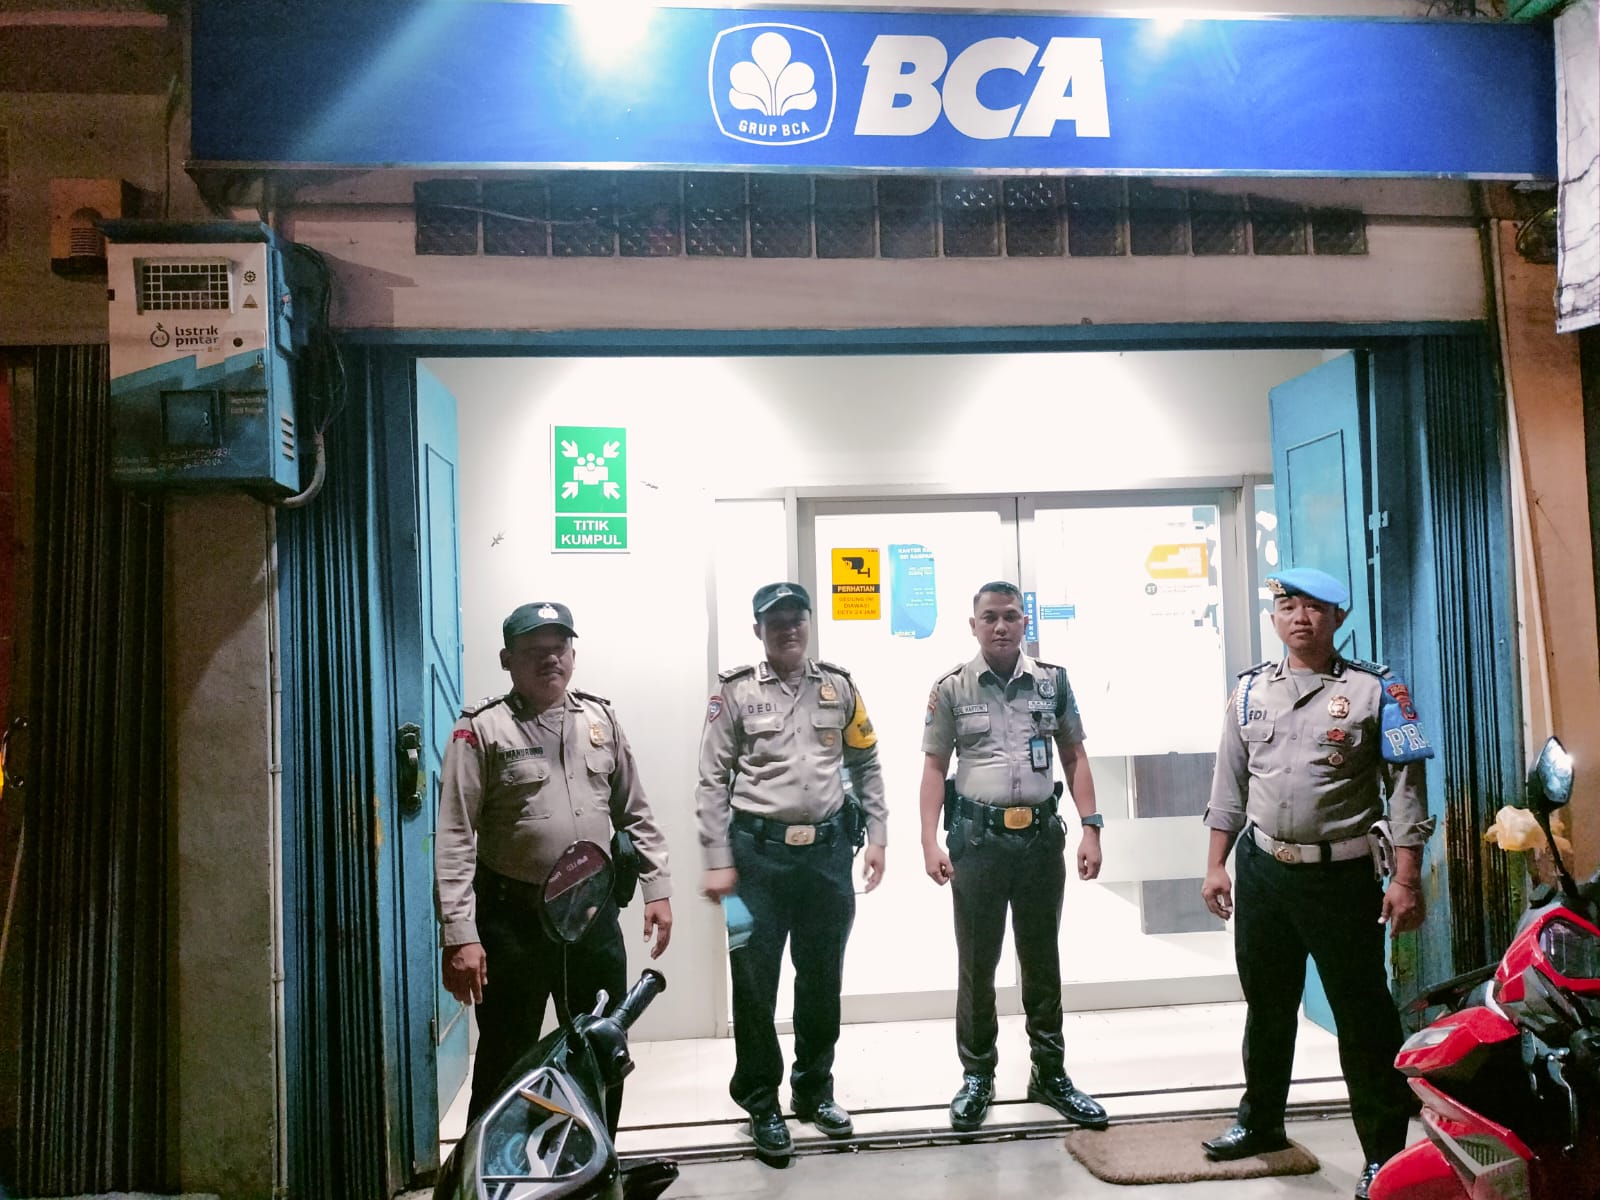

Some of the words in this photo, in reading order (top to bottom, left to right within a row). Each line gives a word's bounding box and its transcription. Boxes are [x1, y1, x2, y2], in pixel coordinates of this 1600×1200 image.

[854, 35, 1110, 139] BCA
[738, 119, 777, 137] GRUP
[782, 120, 810, 137] BCA
[175, 337, 219, 347] pintar
[573, 520, 609, 531] TITIK
[561, 534, 622, 545] KUMPUL
[837, 585, 875, 593] PERHATIAN
[747, 703, 777, 714] DEDI
